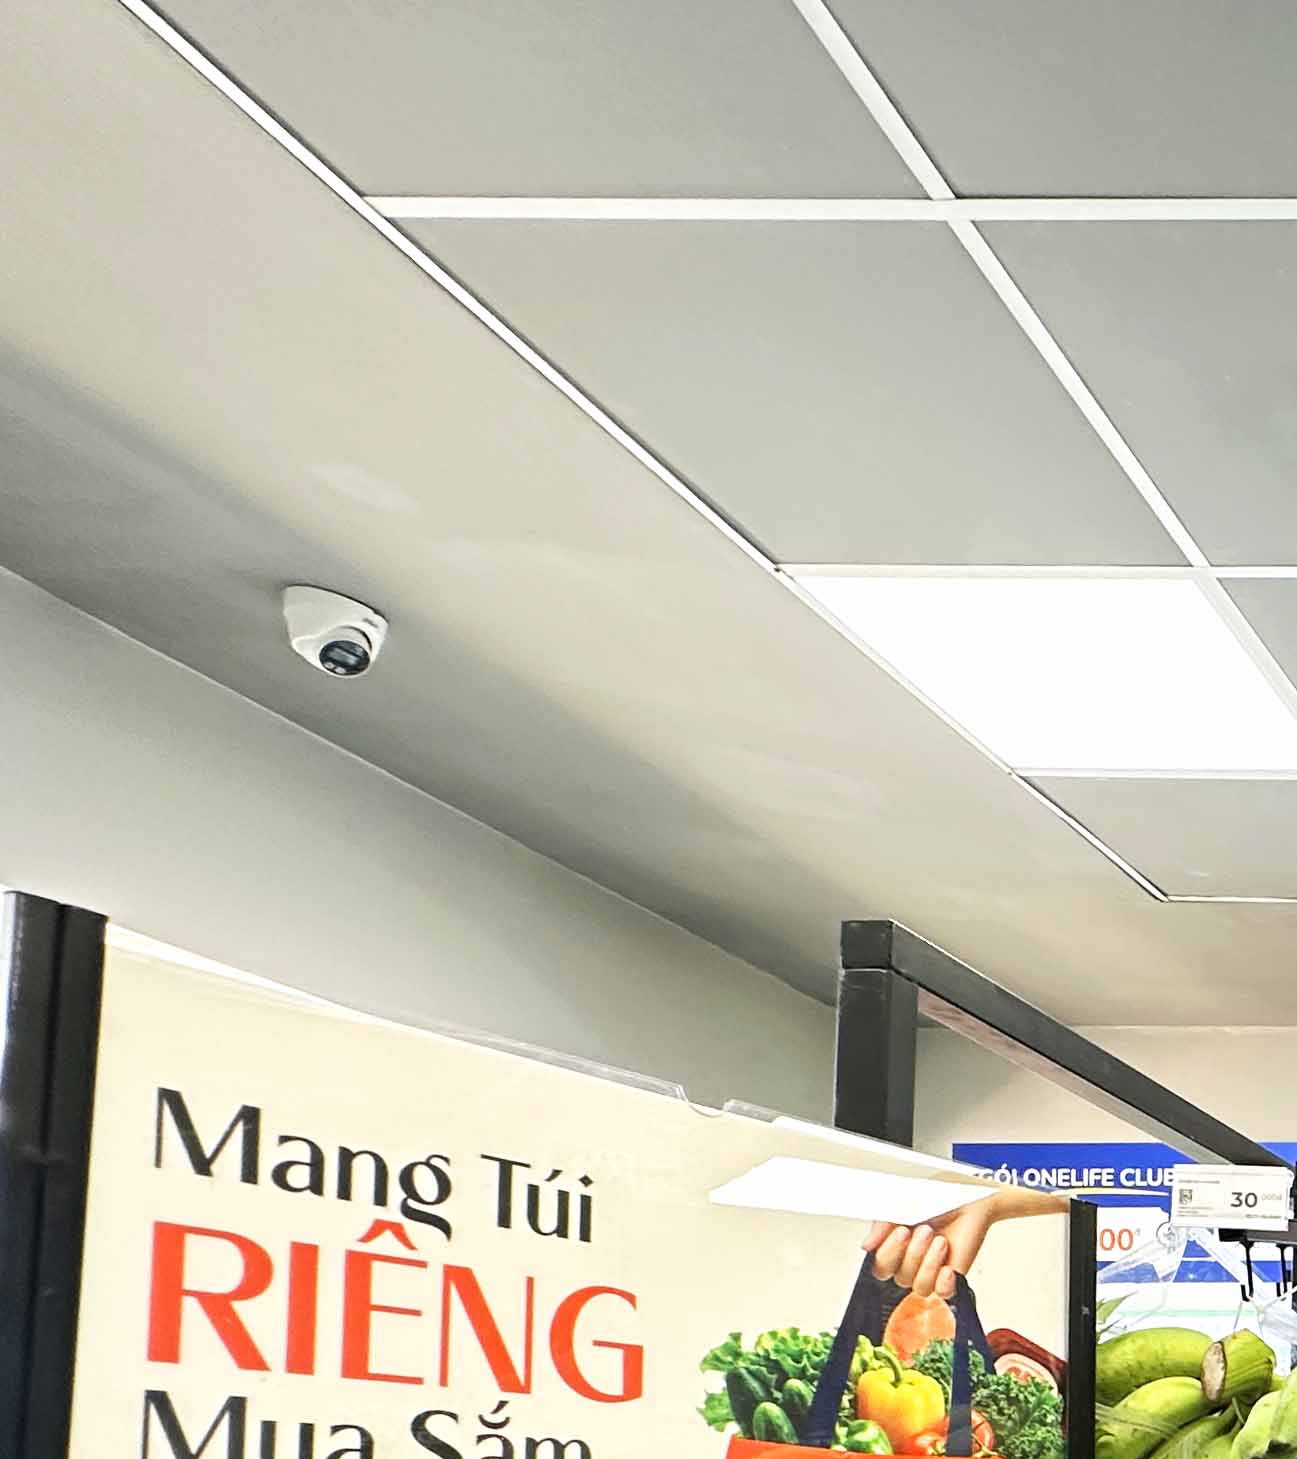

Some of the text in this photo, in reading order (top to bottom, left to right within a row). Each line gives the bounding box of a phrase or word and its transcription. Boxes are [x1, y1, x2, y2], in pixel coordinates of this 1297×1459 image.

[152, 1087, 593, 1242] Mang Túi
[1024, 1167, 1115, 1187] ONELIFE
[1119, 1168, 1174, 1187] CLUB
[1230, 1192, 1258, 1208] 30
[147, 1219, 644, 1403] RIÊNG
